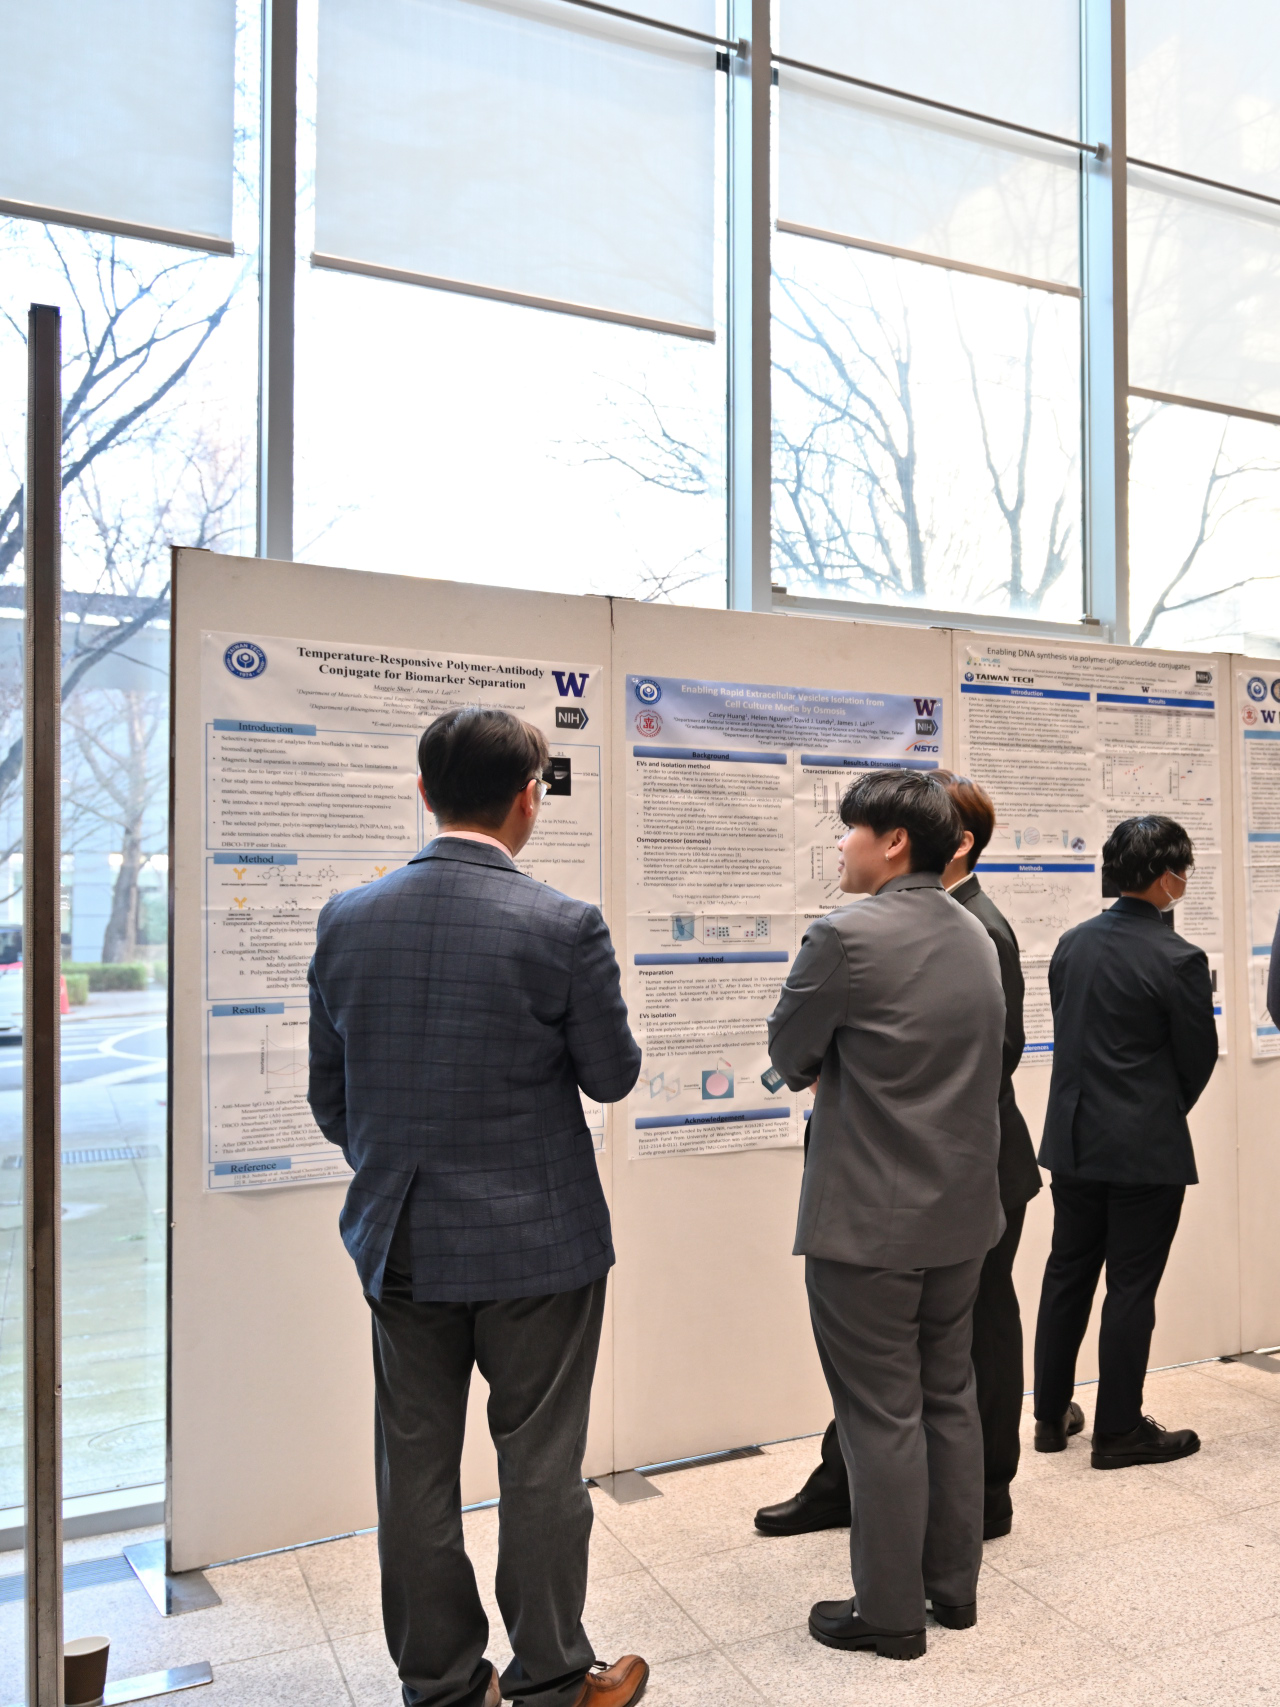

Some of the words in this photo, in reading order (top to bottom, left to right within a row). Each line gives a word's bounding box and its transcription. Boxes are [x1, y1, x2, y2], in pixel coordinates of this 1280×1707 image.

[228, 643, 248, 657] TAIWAN
[250, 644, 263, 658] TECH
[297, 647, 444, 670] Temperature-Responsive
[446, 660, 544, 678] Polymer-Antibody
[987, 648, 1016, 657] Enabling
[1037, 652, 1067, 661] synthesis
[1080, 656, 1156, 667] polymer-oligonucleotide
[1158, 662, 1190, 671] conjugates
[319, 664, 380, 679] Conjugate
[384, 669, 401, 679] for
[405, 671, 465, 684] Biomarker
[468, 677, 526, 689] Separation
[975, 673, 1009, 682] TAIWAN
[551, 671, 589, 697] W
[681, 685, 718, 696] Enabling
[720, 688, 743, 697] Rapid
[746, 691, 795, 700] Extracellular
[798, 694, 829, 702] Vesicles
[831, 696, 864, 704] Isolation
[743, 701, 772, 709] Culture
[775, 702, 799, 712] Media
[802, 706, 811, 714] by
[814, 707, 846, 715] Osmosis
[914, 699, 937, 716] W
[558, 712, 580, 724] NIH
[1261, 710, 1276, 723] W
[239, 722, 293, 733] Introduction
[917, 723, 932, 731] NIH
[238, 855, 274, 863] Method
[232, 1006, 265, 1014] Results
[685, 1115, 745, 1125] Acknowledgement
[231, 1162, 276, 1173] Reference
